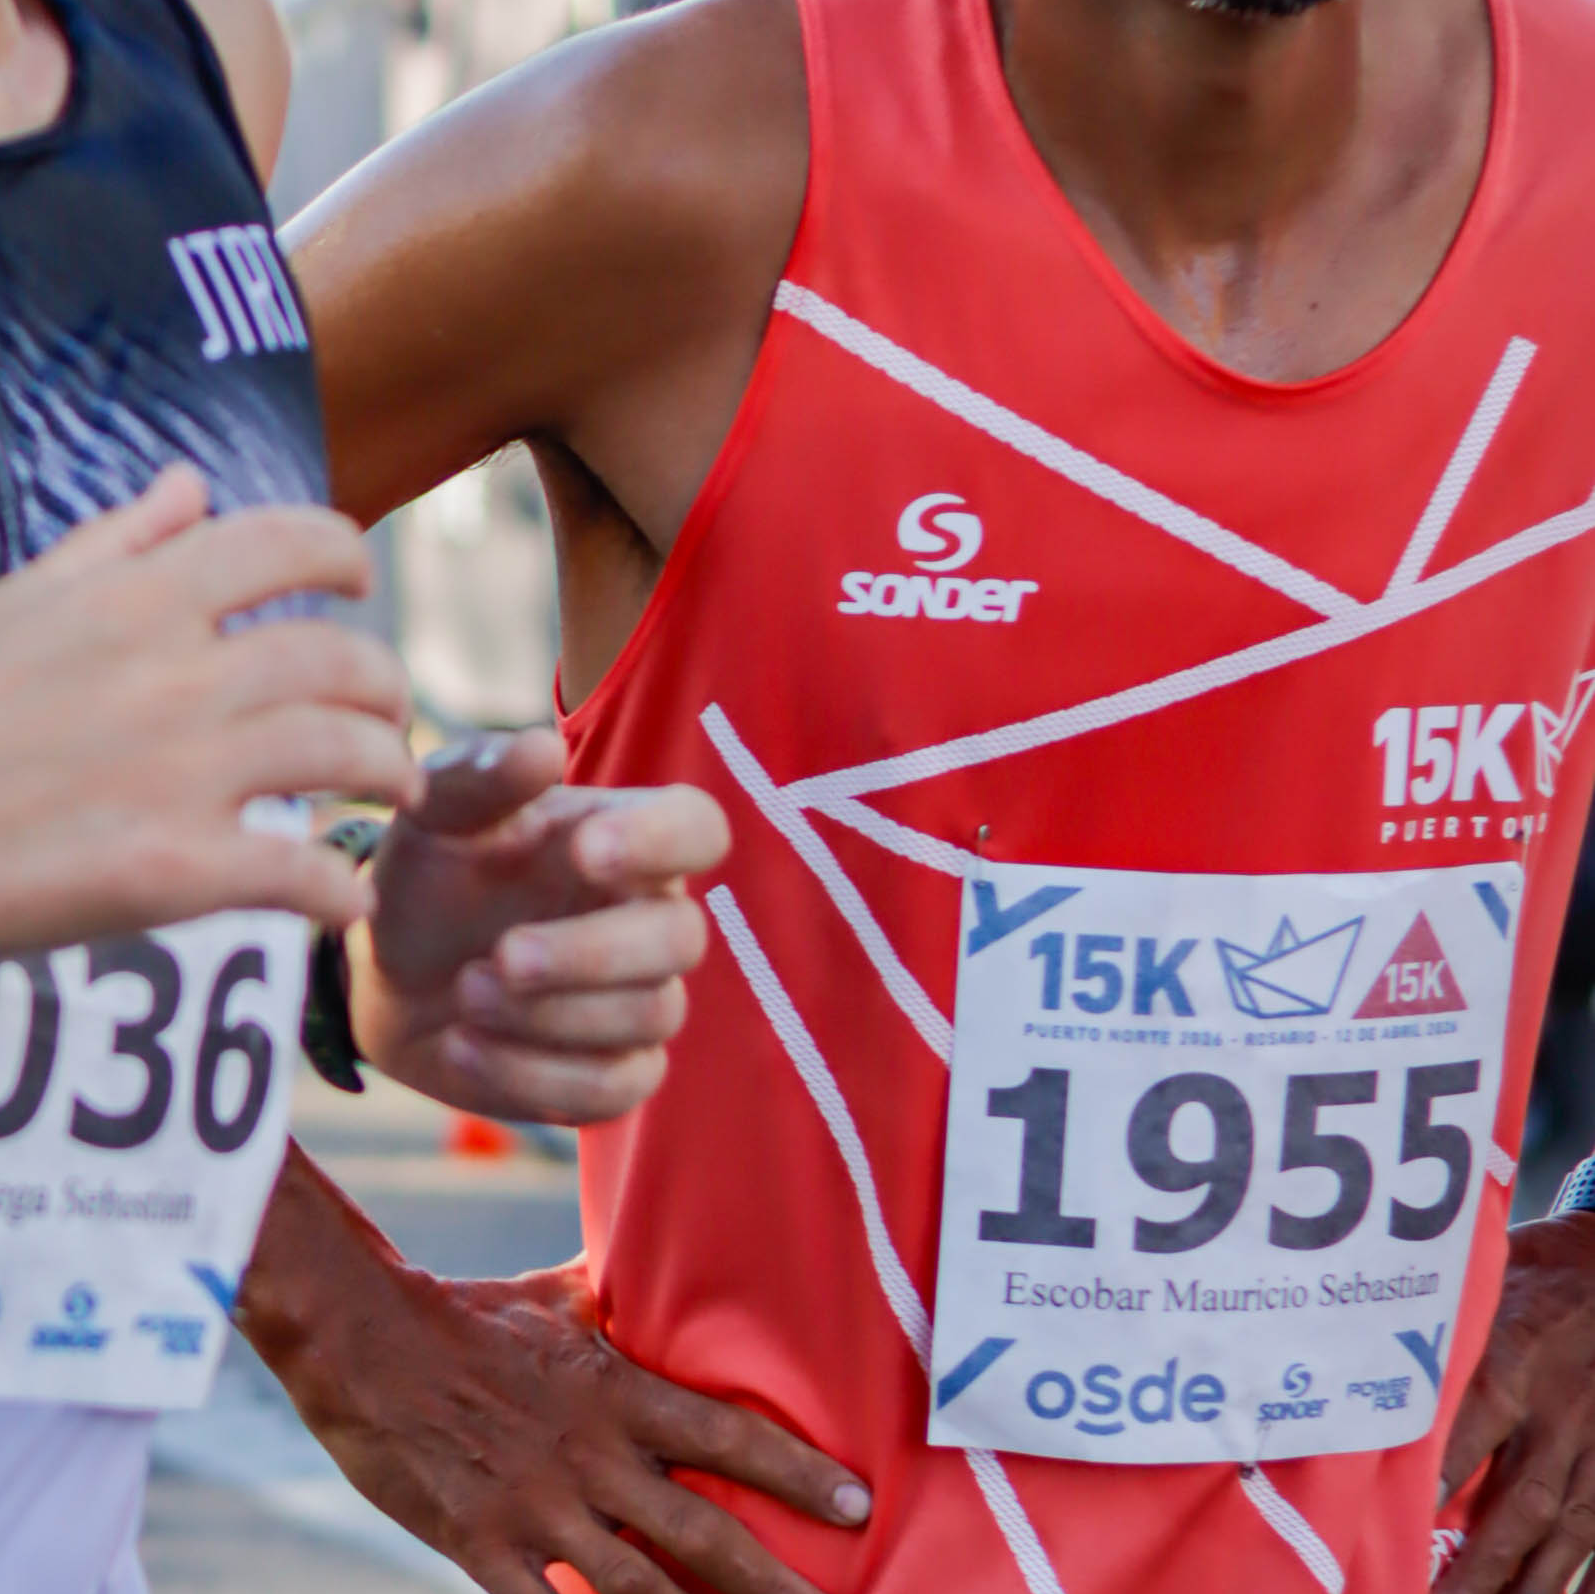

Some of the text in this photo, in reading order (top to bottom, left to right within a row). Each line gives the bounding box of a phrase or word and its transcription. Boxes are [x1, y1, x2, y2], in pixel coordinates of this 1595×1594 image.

[1372, 702, 1527, 807] 15K
[1380, 815, 1518, 845] PUERTO
[1028, 931, 1200, 1018] 15K
[1385, 958, 1446, 1005] 15K
[1022, 1021, 1102, 1043] PUERTO
[1109, 1027, 1171, 1047] NORTE
[1244, 1029, 1316, 1047] ROSARIO
[1358, 1025, 1377, 1042] DE
[1381, 1022, 1421, 1039] ABRIL
[977, 1058, 1483, 1254] 1955
[1003, 1267, 1441, 1313] Escobar Mauricio Sebastian
[1024, 1356, 1228, 1437] osde
